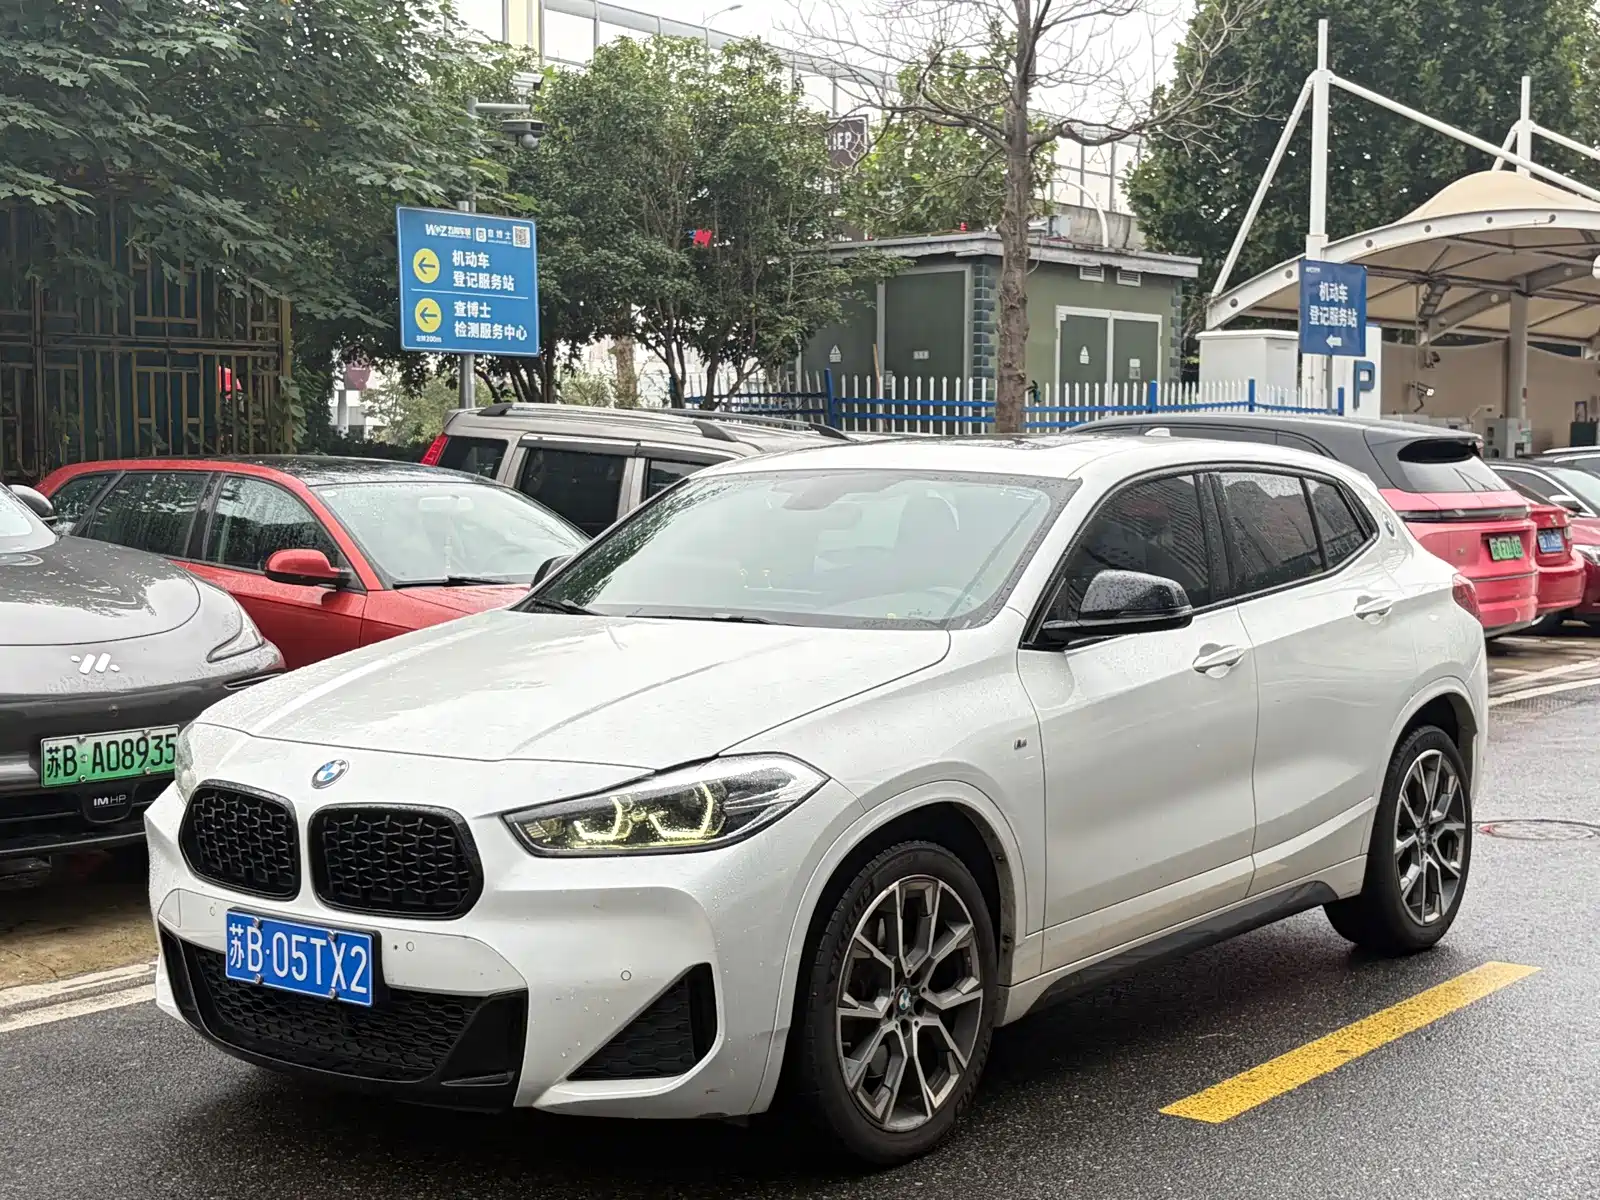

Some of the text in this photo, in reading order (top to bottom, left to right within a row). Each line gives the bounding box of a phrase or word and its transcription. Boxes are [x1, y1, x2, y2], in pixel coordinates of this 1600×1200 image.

[451, 249, 491, 269] 机动车
[453, 270, 515, 292] 登记服务站
[1318, 281, 1349, 304] 机动车
[453, 300, 492, 319] 查博士
[1309, 305, 1358, 329] 登记服务站
[454, 321, 528, 341] 检测服务中心
[1353, 360, 1376, 411] P
